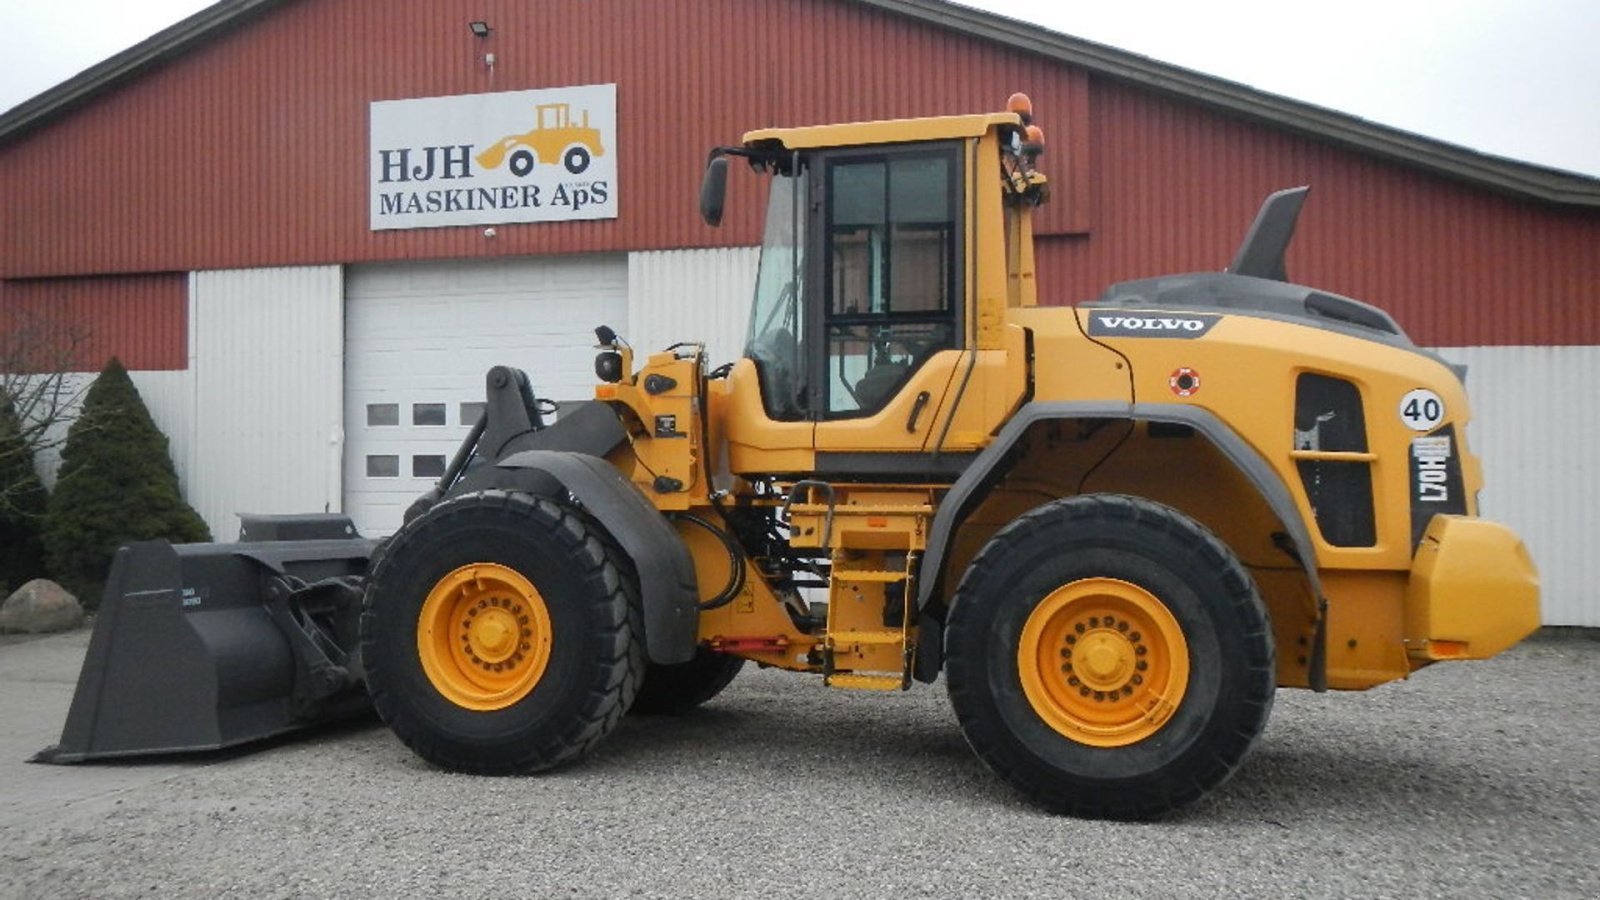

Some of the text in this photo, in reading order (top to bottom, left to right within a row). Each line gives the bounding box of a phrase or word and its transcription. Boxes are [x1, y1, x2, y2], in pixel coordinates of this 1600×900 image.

[378, 144, 474, 182] HJH
[379, 181, 608, 215] MASKINER ApS
[1098, 317, 1204, 331] VOLVO
[1403, 398, 1440, 421] 40
[1418, 456, 1448, 501] L70H
